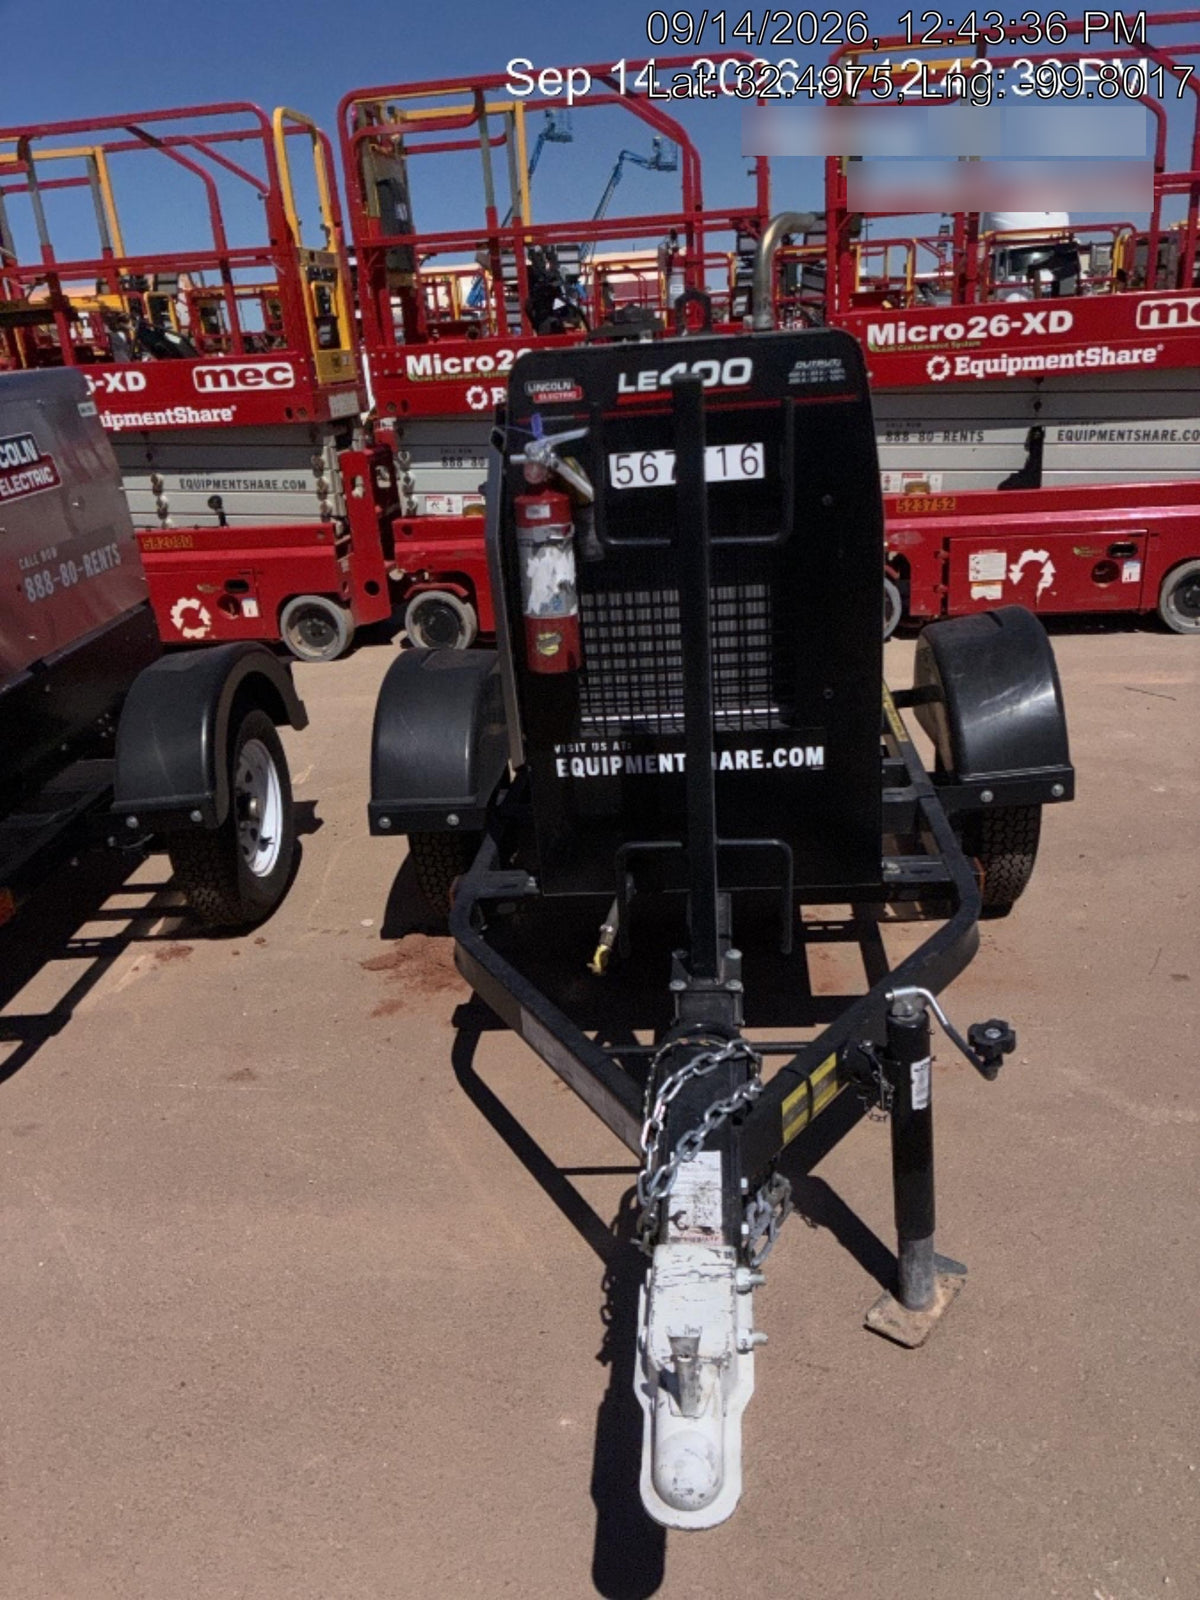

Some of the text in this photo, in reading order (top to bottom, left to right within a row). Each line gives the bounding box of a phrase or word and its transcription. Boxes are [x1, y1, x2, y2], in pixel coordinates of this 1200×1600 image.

[866, 310, 1074, 347] Micro26-XD
[406, 348, 533, 376] Micro2
[194, 364, 294, 390] mec
[526, 381, 572, 392] LINCOLN
[537, 391, 577, 400] ELECTRIC
[885, 430, 985, 443] 888-80-RENTS
[614, 443, 760, 487] 56716
[0, 466, 54, 497] ELECTRIC
[178, 478, 307, 490] EQUIPMENTSHARE.COM
[18, 555, 39, 571] CALL
[24, 543, 123, 603] 888-80-RENTS
[554, 742, 586, 754] VISIT
[591, 741, 608, 753] US
[555, 746, 825, 778] EQUIPMENTARE.COM
